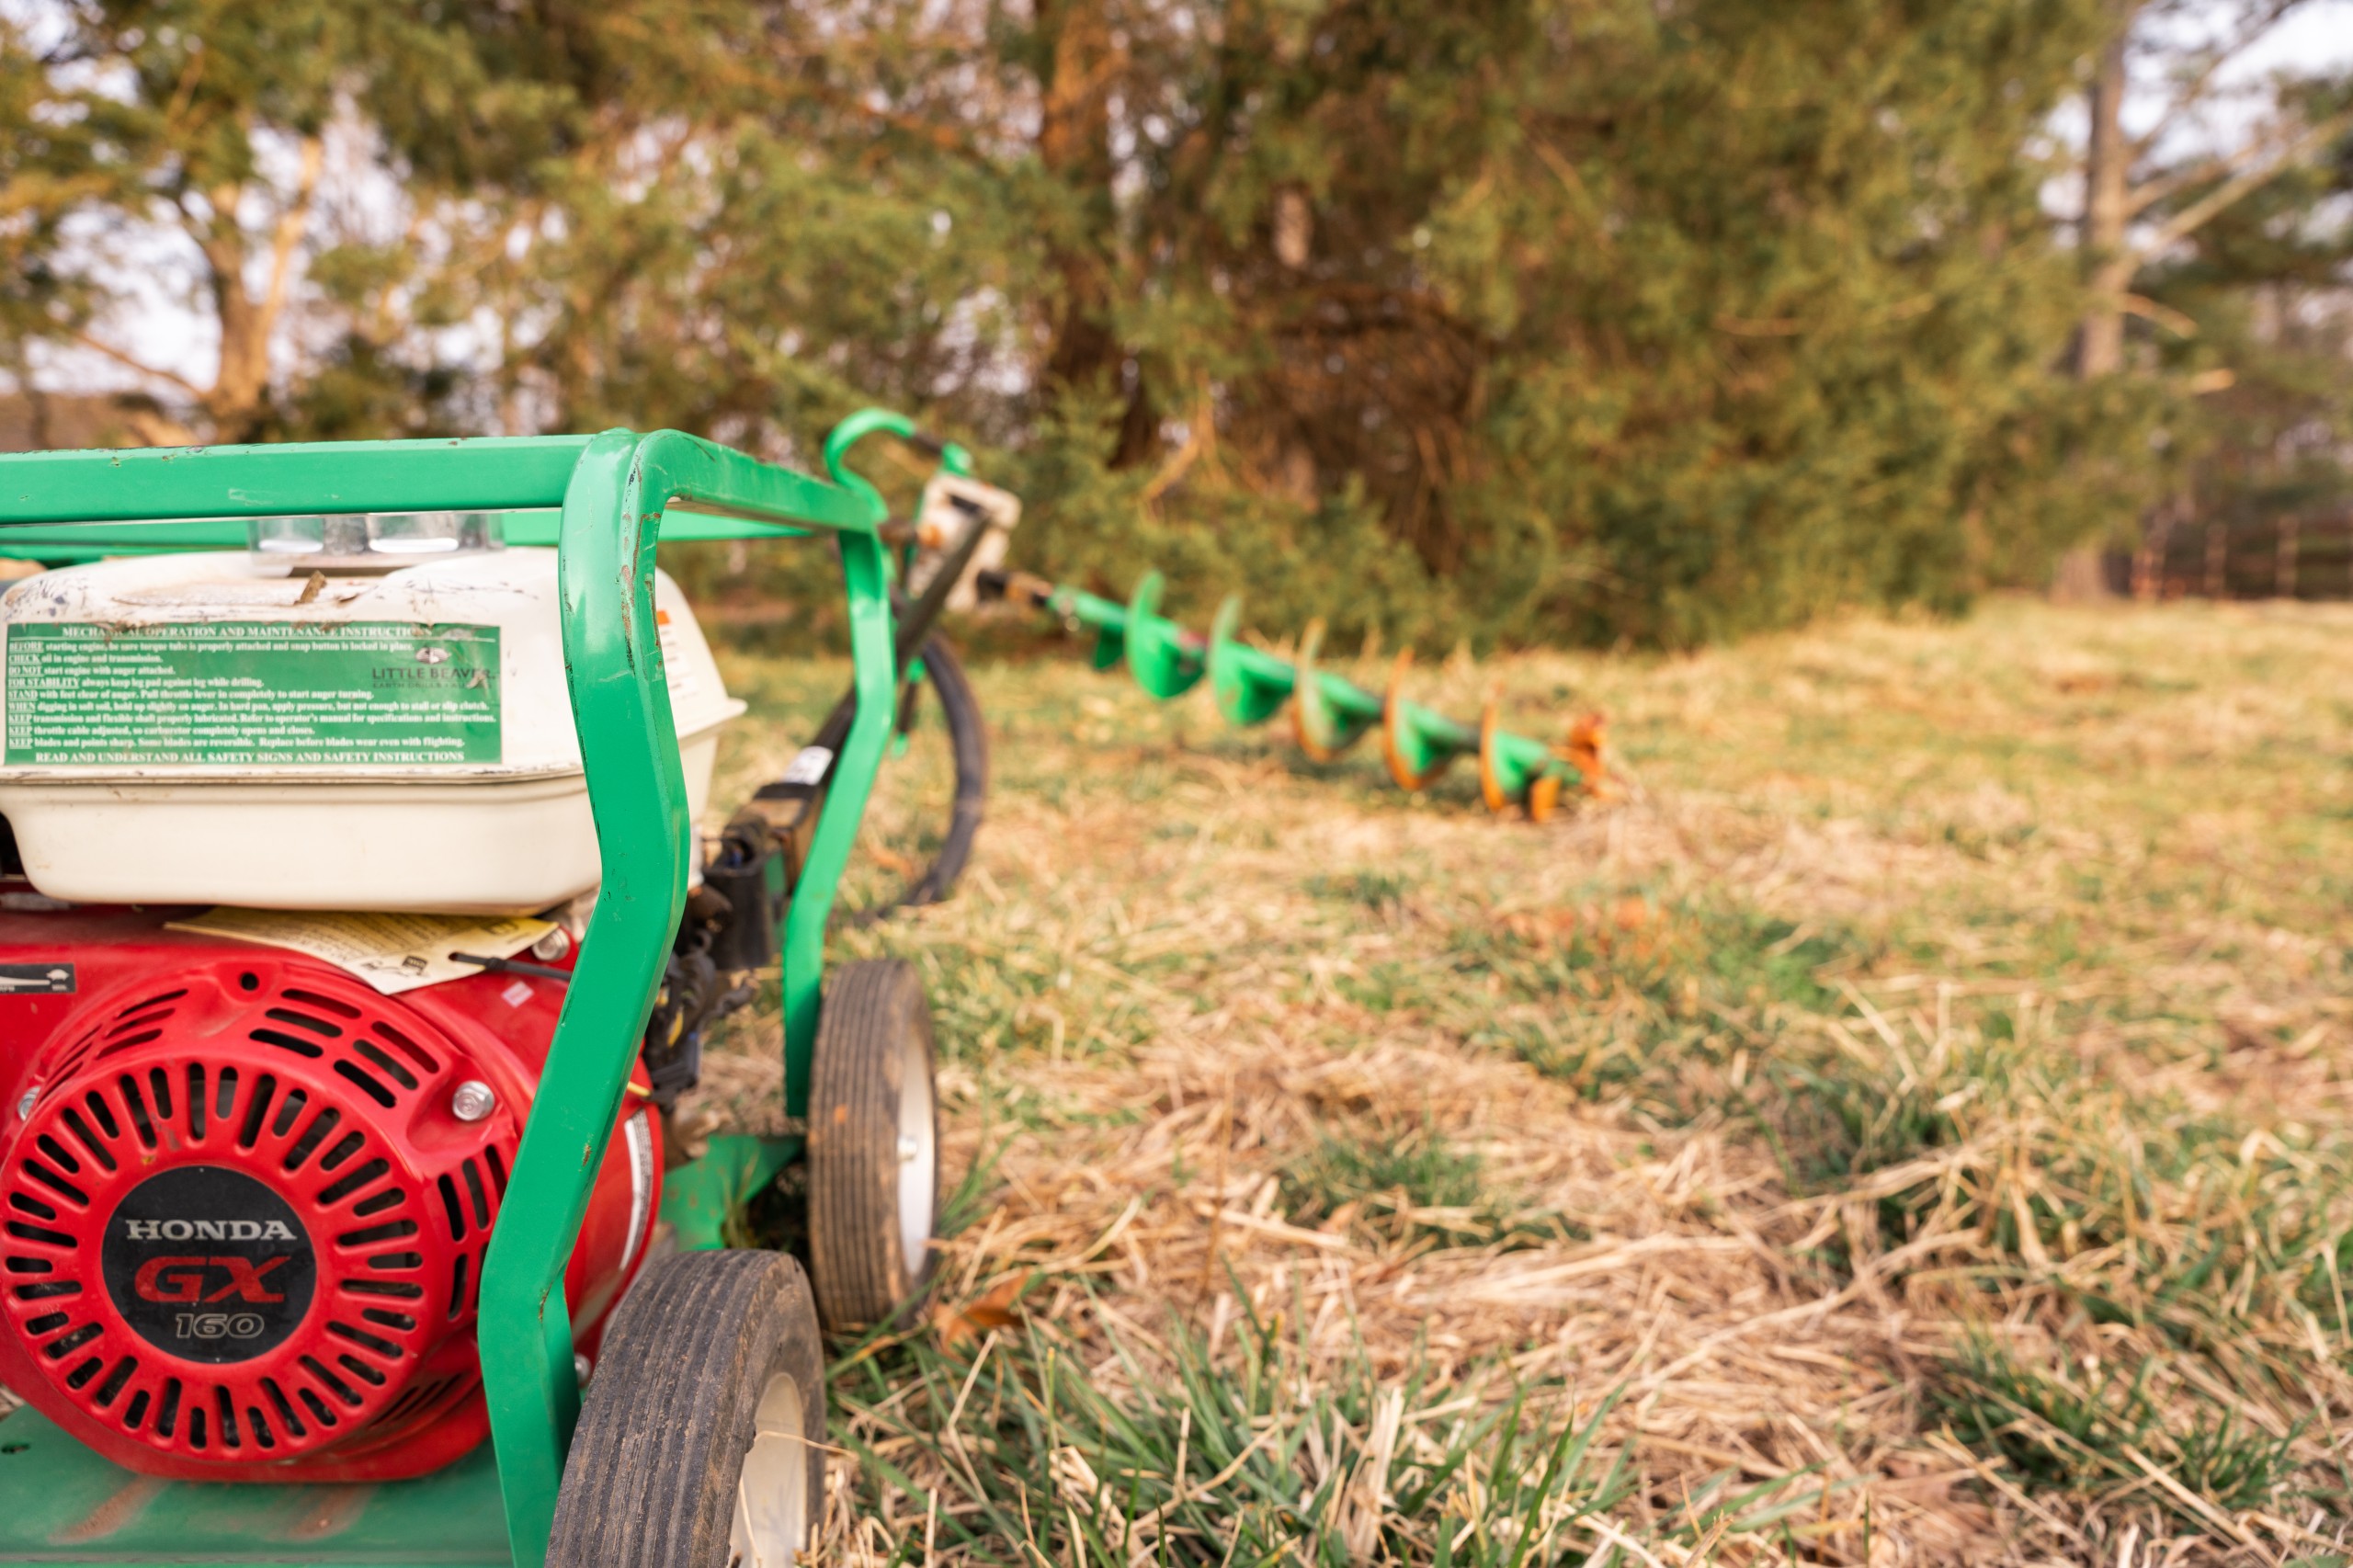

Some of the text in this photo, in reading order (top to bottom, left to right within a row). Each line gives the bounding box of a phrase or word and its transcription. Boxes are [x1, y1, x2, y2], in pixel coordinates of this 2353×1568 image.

[63, 627, 141, 636] MECHAAL
[144, 627, 216, 636] OPERATION
[221, 627, 244, 636] AND
[372, 668, 425, 678] LITTLE
[36, 752, 464, 763] READ AND UNDERSTAND ALL SAFETY SIGNS AND SAFETY INSTRUCTIONS
[126, 1220, 297, 1240] HONDA
[134, 1256, 291, 1302] GX
[176, 1313, 265, 1338] 160
